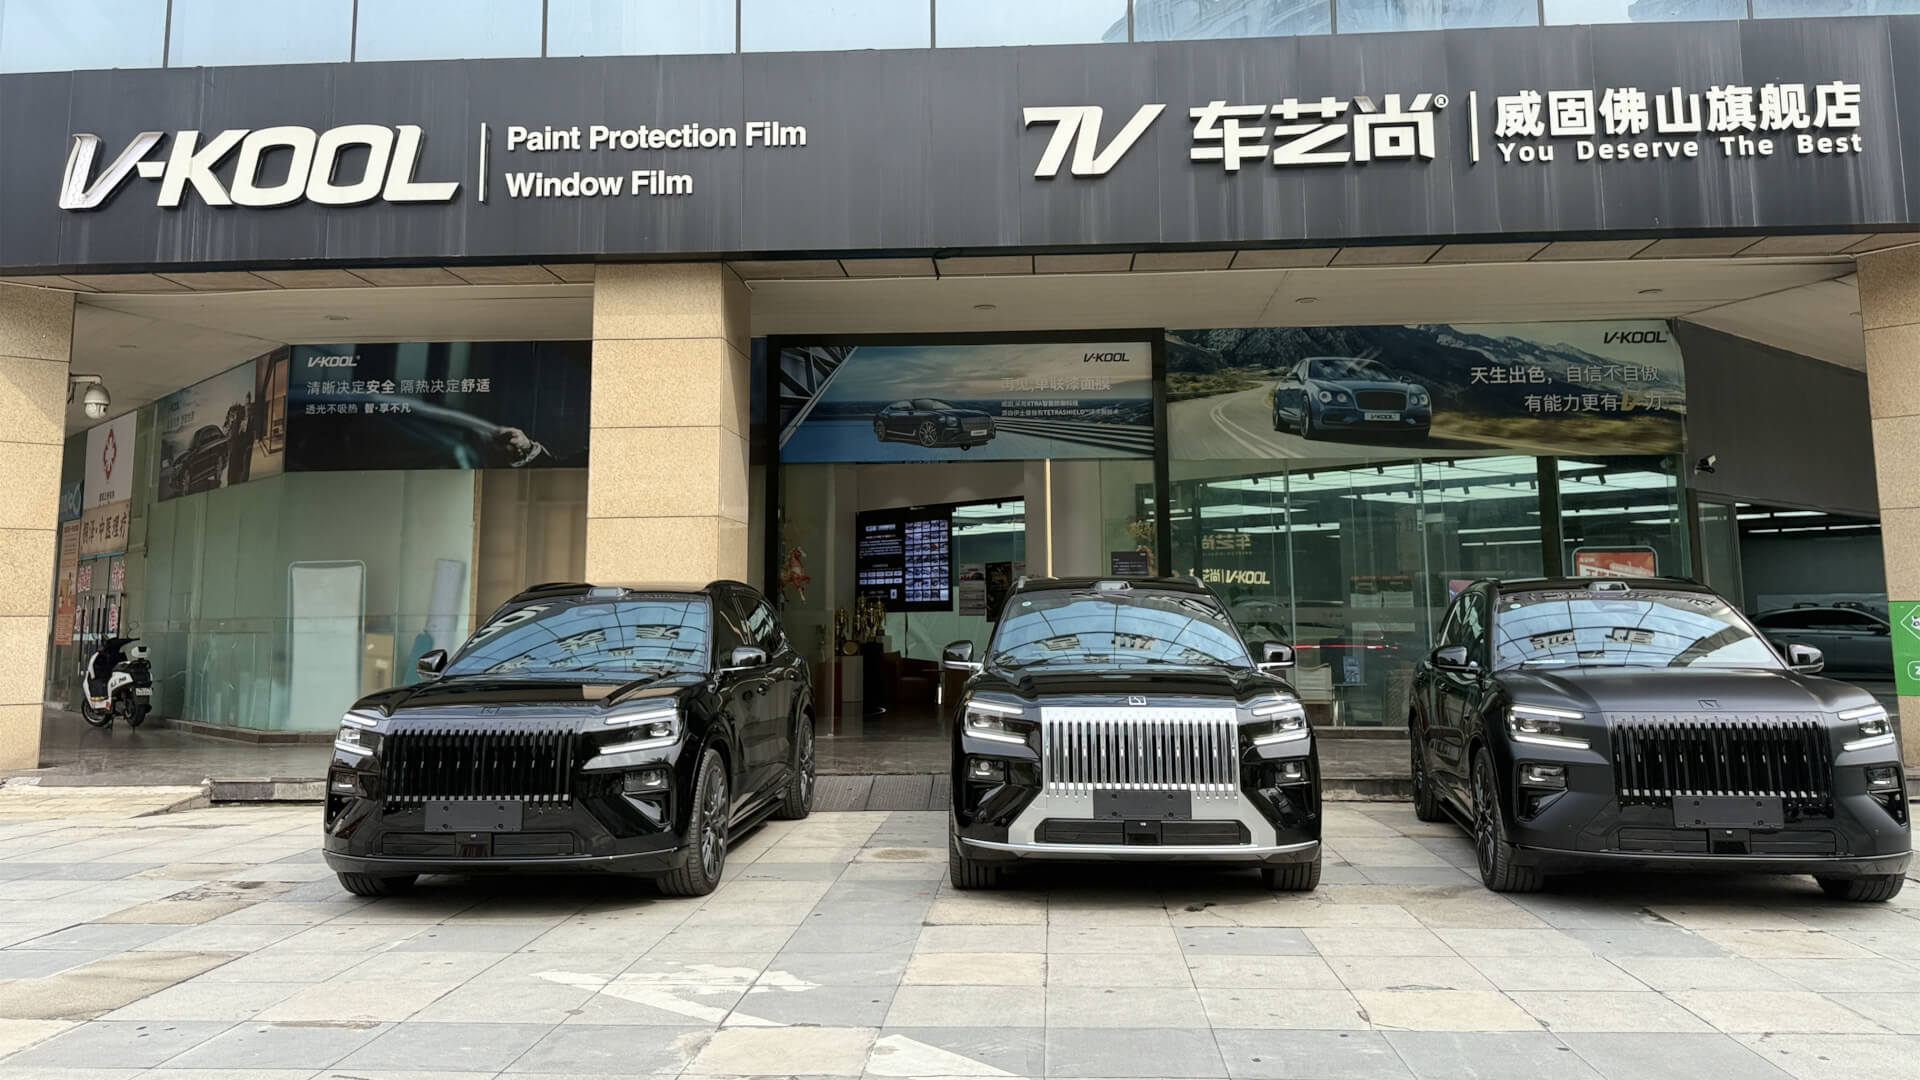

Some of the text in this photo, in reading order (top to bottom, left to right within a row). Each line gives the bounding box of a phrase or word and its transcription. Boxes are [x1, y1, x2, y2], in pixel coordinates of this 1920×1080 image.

[1495, 81, 1861, 137] 威固佛山旗舰店
[507, 121, 807, 153] Paint Protection Film
[1497, 133, 1863, 162] You Deserve The Best
[59, 124, 460, 210] V-KOOL
[505, 170, 693, 199] Window Film
[306, 378, 491, 395] 清晰决定安全 隔热决定舒适
[305, 403, 358, 415] 透光不吸热
[1225, 569, 1270, 585] V-KOOL
